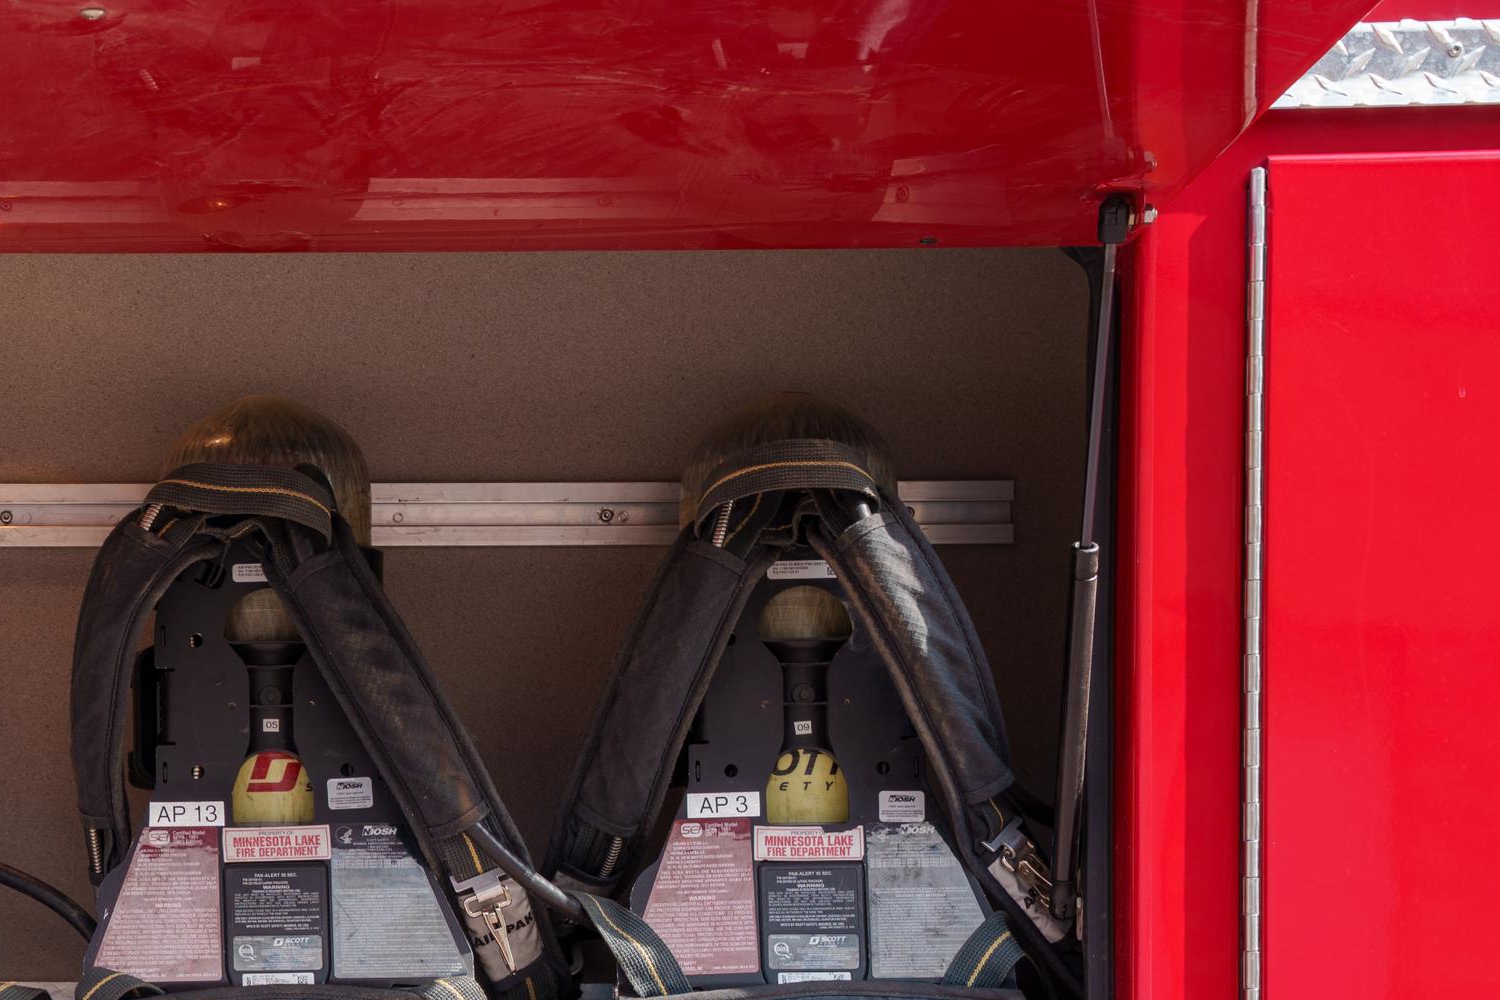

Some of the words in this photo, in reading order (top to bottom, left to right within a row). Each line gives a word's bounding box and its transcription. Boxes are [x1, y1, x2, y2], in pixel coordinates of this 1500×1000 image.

[700, 796, 728, 813] AP
[736, 795, 748, 813] 3
[157, 806, 186, 822] AP
[195, 805, 217, 822] 13
[362, 825, 397, 836] NIOSH
[233, 836, 292, 847] MINNESOTA
[295, 834, 320, 845] LAKE
[764, 835, 824, 846] MINNESOTA
[828, 835, 854, 846] LAKE
[236, 847, 256, 857] FIRE
[259, 846, 319, 857] DEPARTMENT
[767, 847, 787, 856] FIRE
[790, 846, 852, 856] DEPARTMENT
